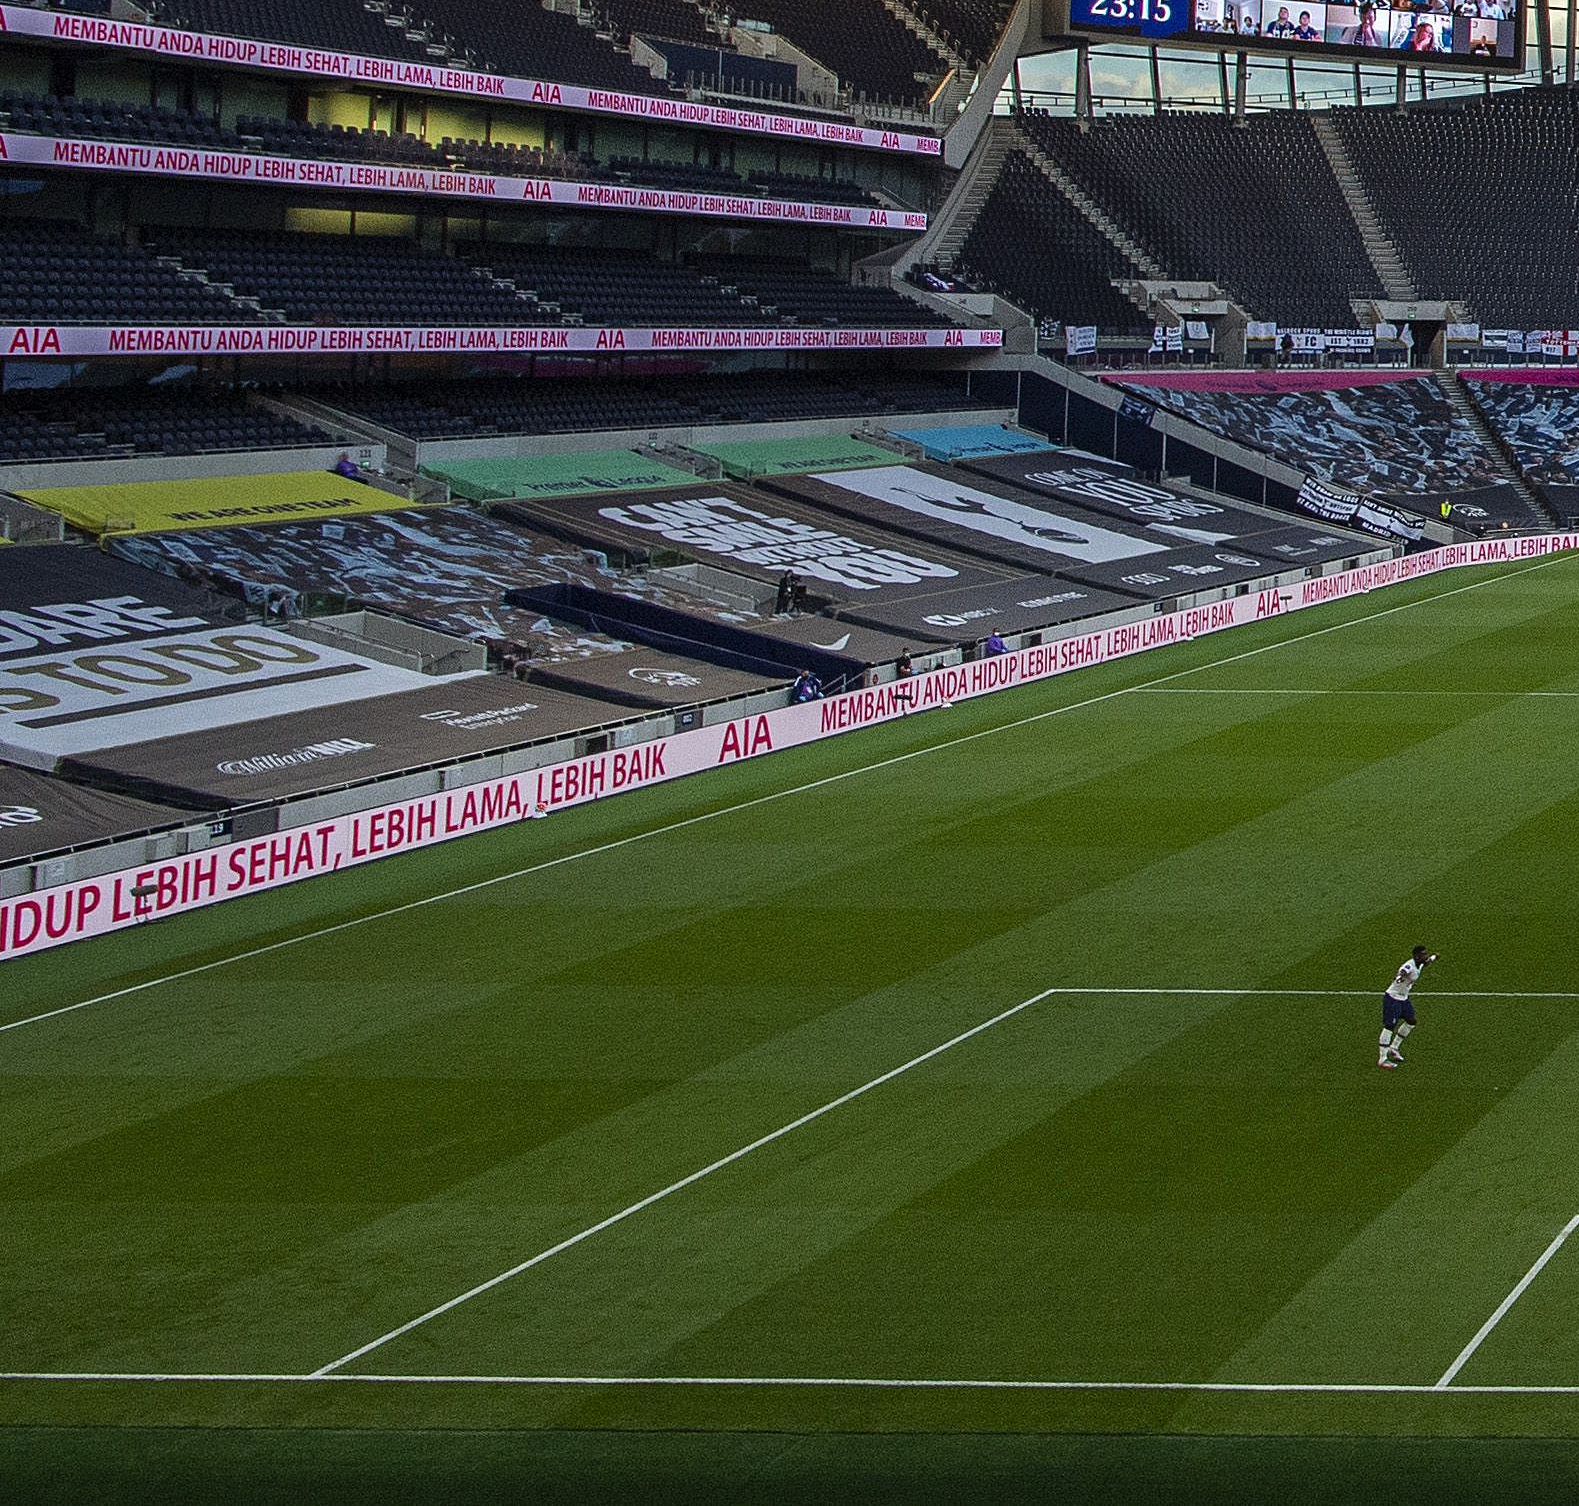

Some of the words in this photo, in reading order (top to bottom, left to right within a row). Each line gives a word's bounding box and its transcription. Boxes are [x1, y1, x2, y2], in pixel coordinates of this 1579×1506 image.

[54, 18, 154, 48] MEMBANTU
[158, 32, 204, 54] ANDA
[208, 42, 257, 61] HIDUP
[261, 47, 301, 67] LEBIH
[305, 53, 352, 73] SEHAT,
[356, 62, 394, 79] LEBIH
[398, 67, 435, 87] LAMA,
[440, 73, 474, 90] LEBIH
[476, 78, 504, 95] BAIK
[532, 84, 562, 103] AIA
[9, 329, 61, 355] AIA
[110, 331, 211, 351] MEMBANTU
[216, 332, 263, 351] ANDA
[269, 331, 317, 351] HIDUP
[321, 332, 363, 350] LEBIH
[366, 332, 414, 349] SEHAT,
[419, 332, 456, 350] LEBIH
[460, 334, 498, 349] LAMA,
[504, 333, 537, 350] LEBIH
[540, 333, 568, 349] BAIK
[596, 331, 625, 350] AIA
[1058, 478, 1176, 507] YOU
[661, 518, 839, 552] SMILE
[764, 548, 960, 590] YOU
[1256, 591, 1281, 613] AIA
[3, 655, 192, 695] TO
[142, 635, 320, 675] DO
[820, 683, 920, 731] MEMBANTU
[923, 671, 968, 703] ANDA
[972, 657, 1018, 690] HIDUP
[1020, 652, 1058, 680] LEBIH
[1061, 637, 1103, 667] SEHAT,
[1107, 631, 1140, 656] LEBIH
[1142, 621, 1177, 646] LAMA,
[1180, 612, 1209, 636] LEBIH
[1212, 606, 1234, 628] BAIK
[718, 717, 774, 763] AIA
[112, 855, 218, 923] LEBIH
[228, 826, 342, 892] SEHAT,
[352, 800, 437, 859] LEBIH
[444, 781, 529, 833] LAMA,
[535, 759, 605, 811] LEBIH
[612, 744, 667, 789] BAIK
